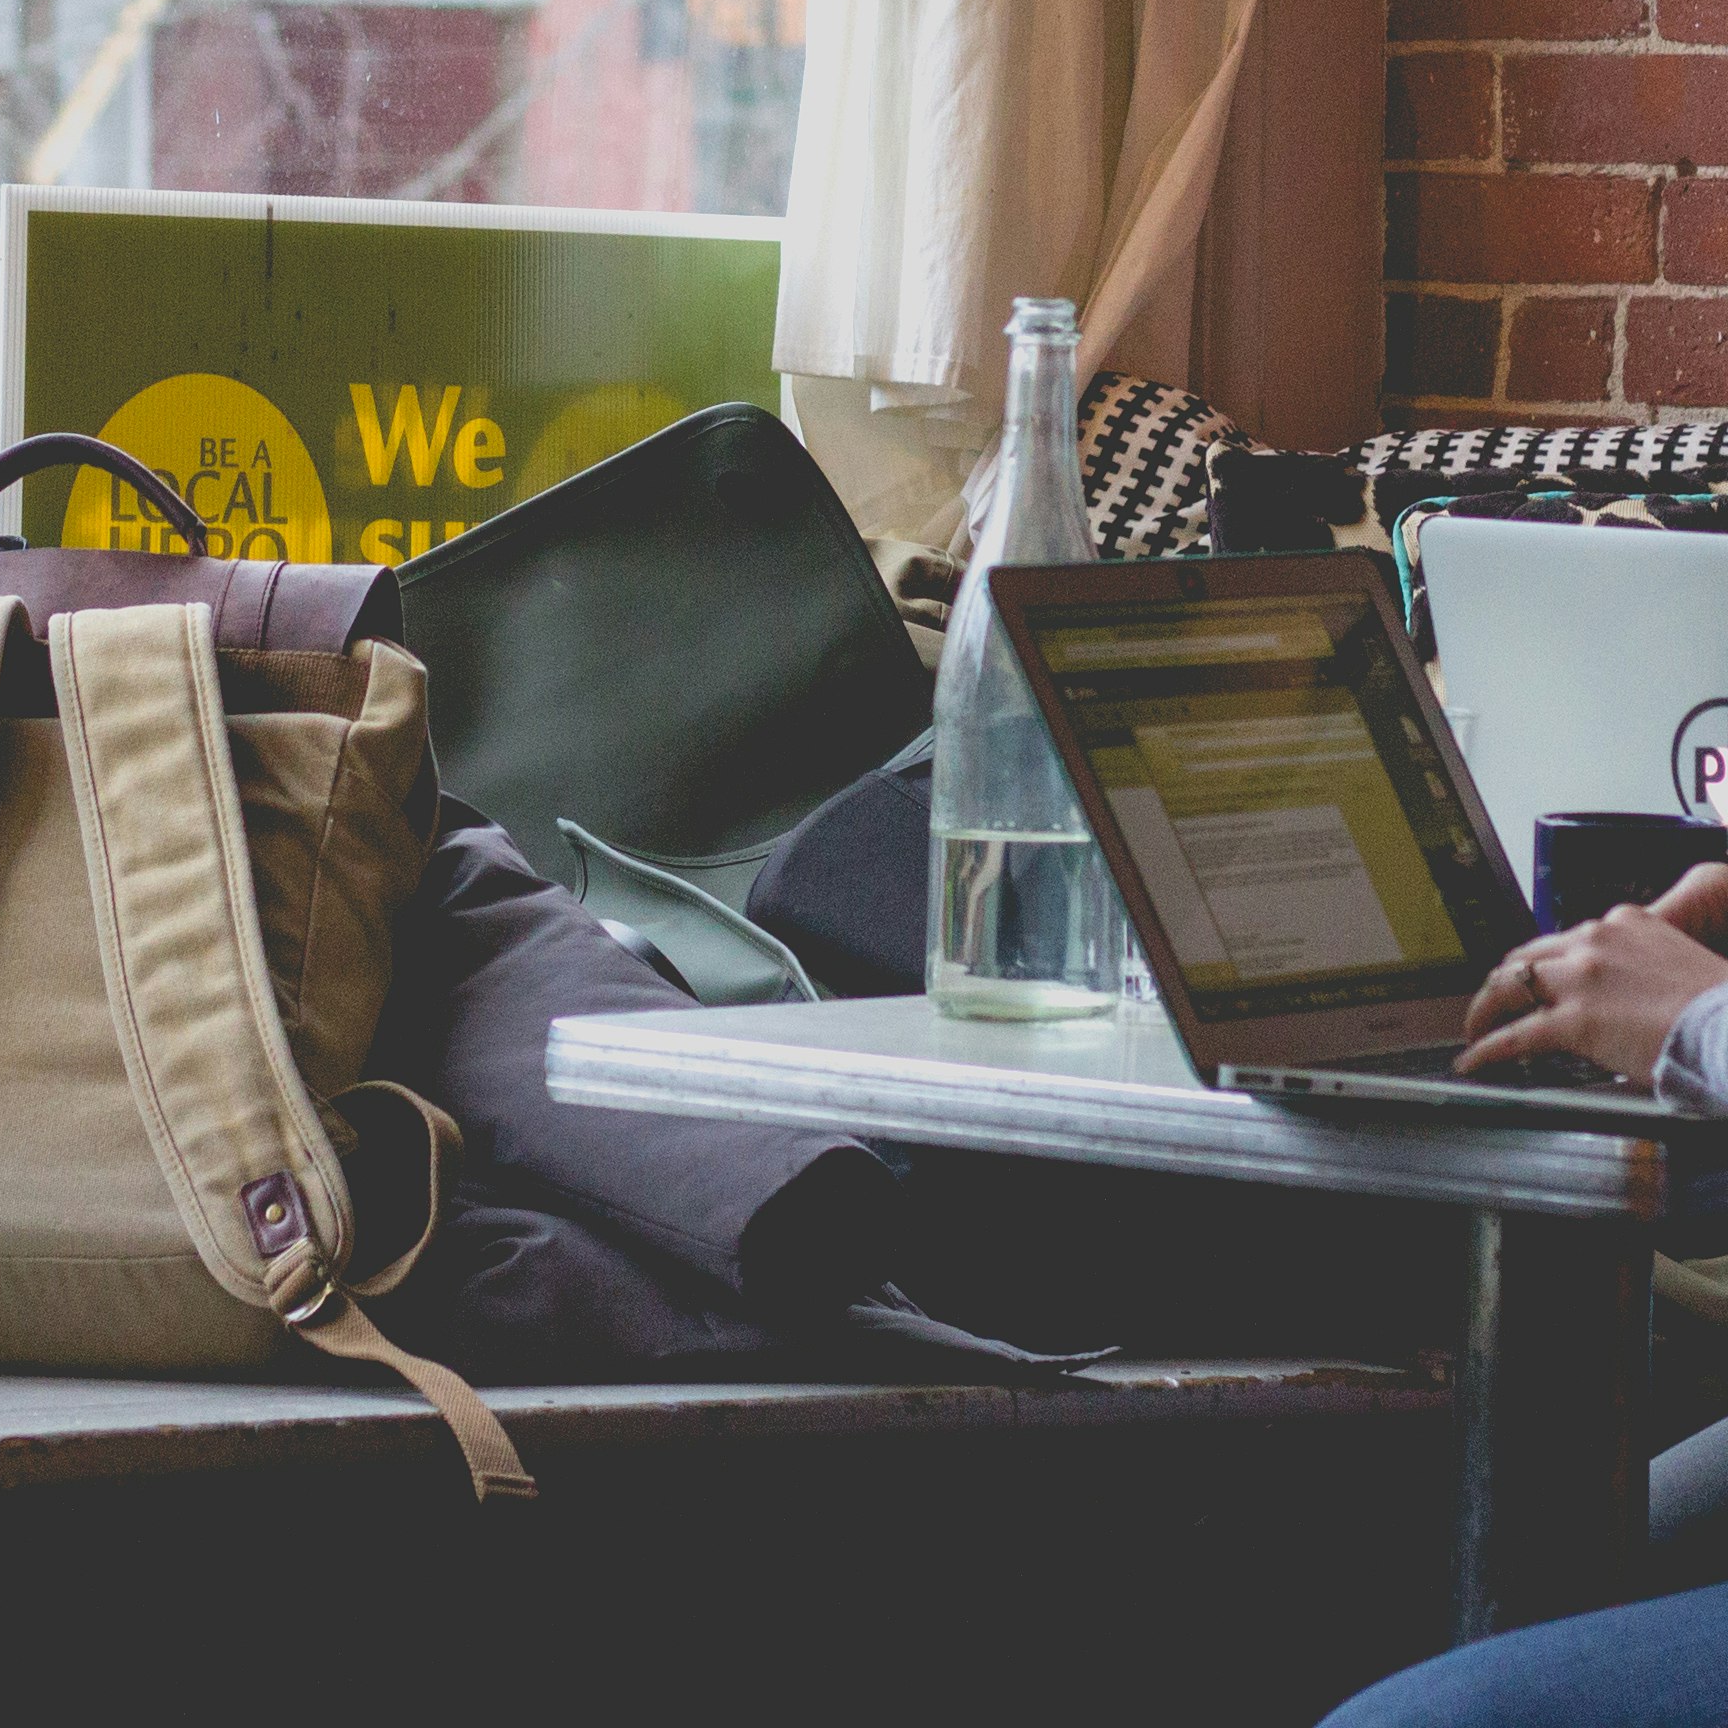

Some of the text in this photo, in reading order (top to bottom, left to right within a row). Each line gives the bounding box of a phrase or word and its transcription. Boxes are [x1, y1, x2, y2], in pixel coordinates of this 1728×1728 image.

[200, 436, 273, 470] BE A
[349, 382, 508, 490] We
